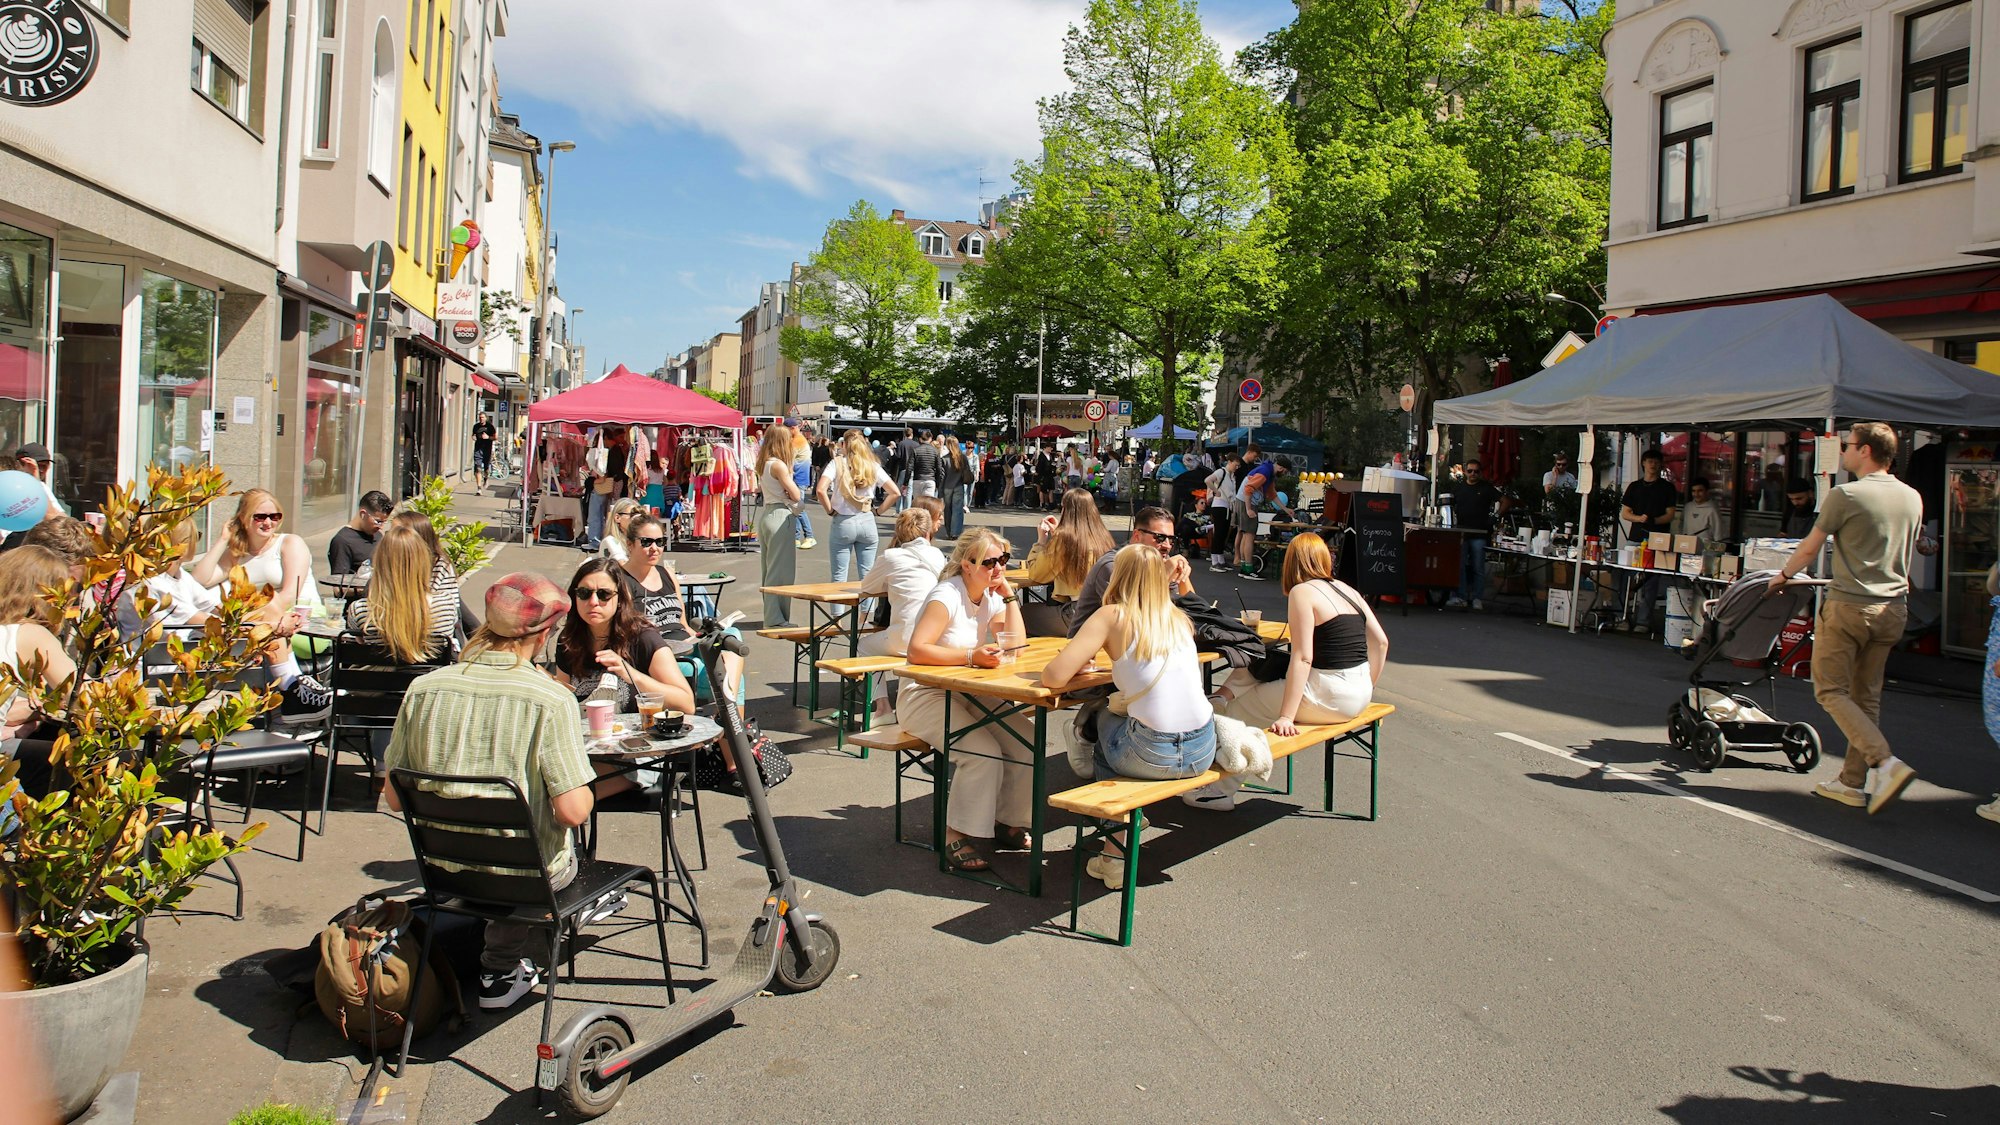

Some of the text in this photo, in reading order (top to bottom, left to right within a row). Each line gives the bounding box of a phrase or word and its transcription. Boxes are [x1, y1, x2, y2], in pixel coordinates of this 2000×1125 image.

[441, 293, 453, 305] Eis
[437, 306, 473, 316] Orchidea
[1089, 405, 1102, 416] 30
[1362, 525, 1393, 539] Espresso
[1363, 540, 1397, 558] Martini
[645, 599, 665, 617] JACK
[726, 702, 743, 735] ninebot
